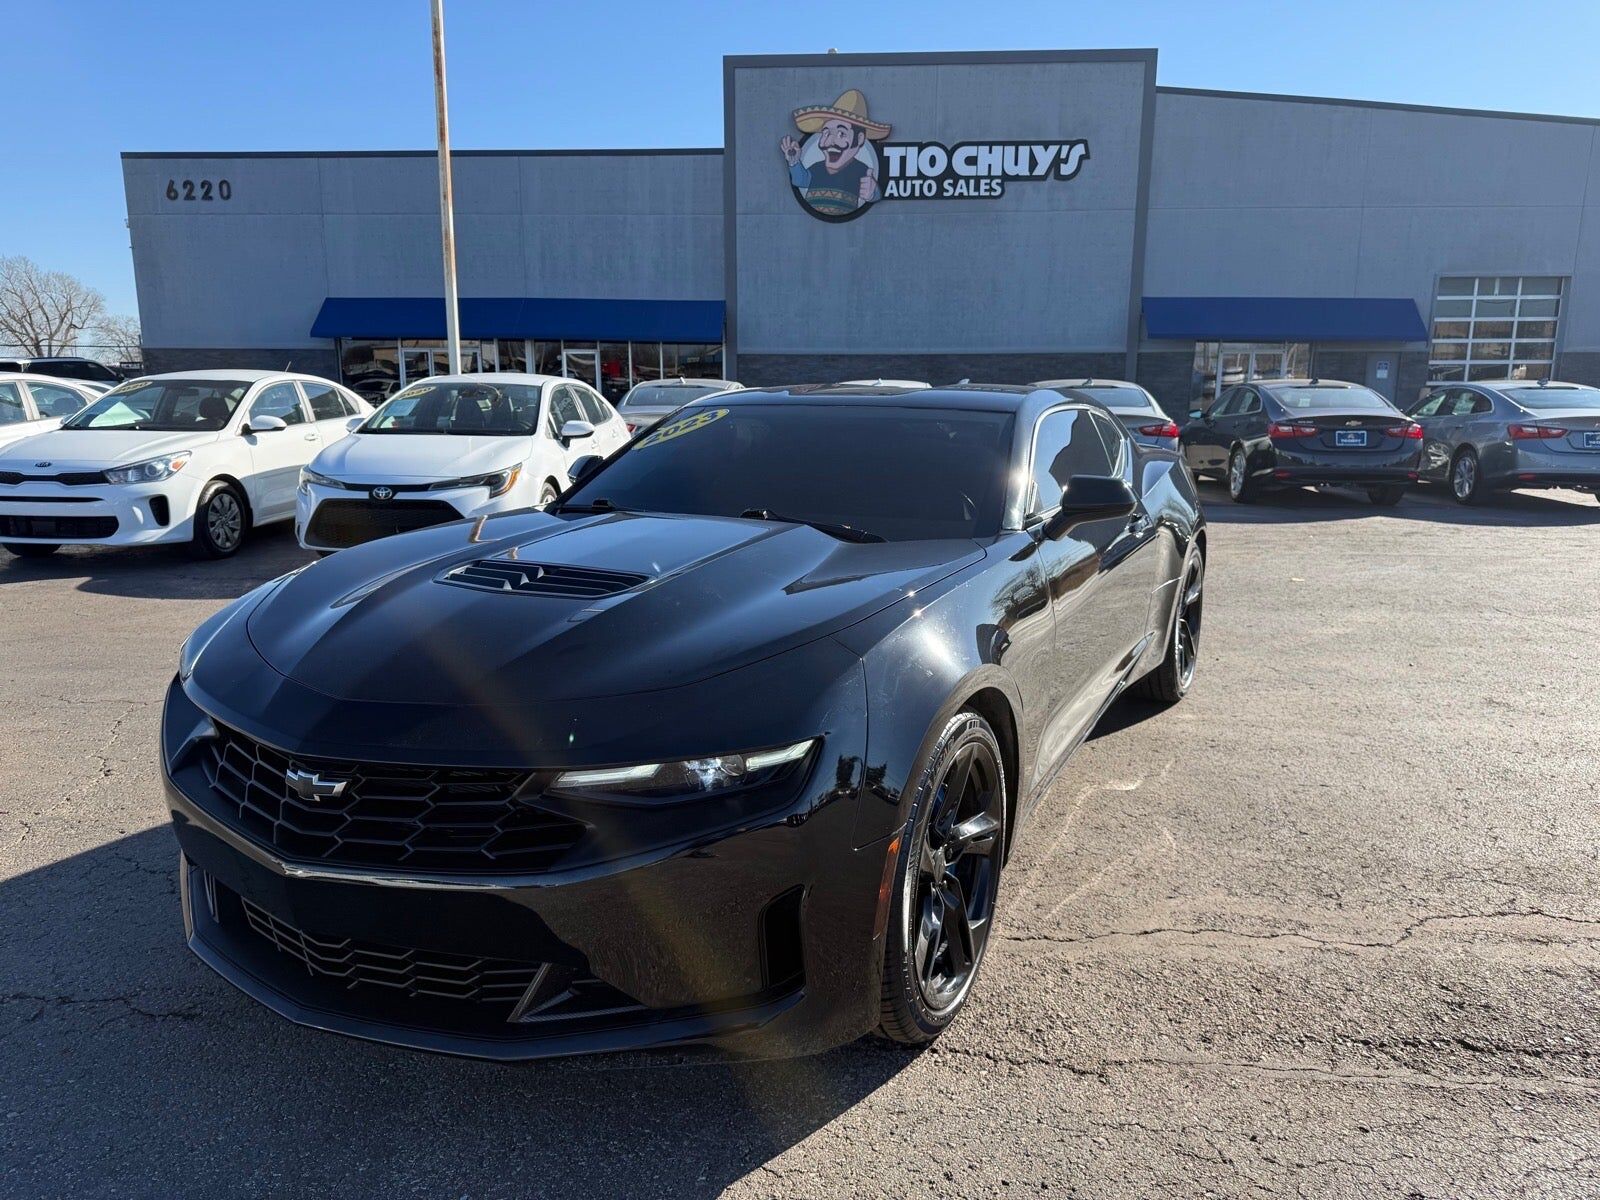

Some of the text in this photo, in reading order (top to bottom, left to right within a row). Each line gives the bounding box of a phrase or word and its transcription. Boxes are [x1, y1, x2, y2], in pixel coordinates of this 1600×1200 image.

[883, 143, 1086, 177] TIO CHUY'S
[166, 179, 232, 201] 6220
[884, 178, 1002, 198] AUTO SALES
[641, 411, 719, 445] 2023
